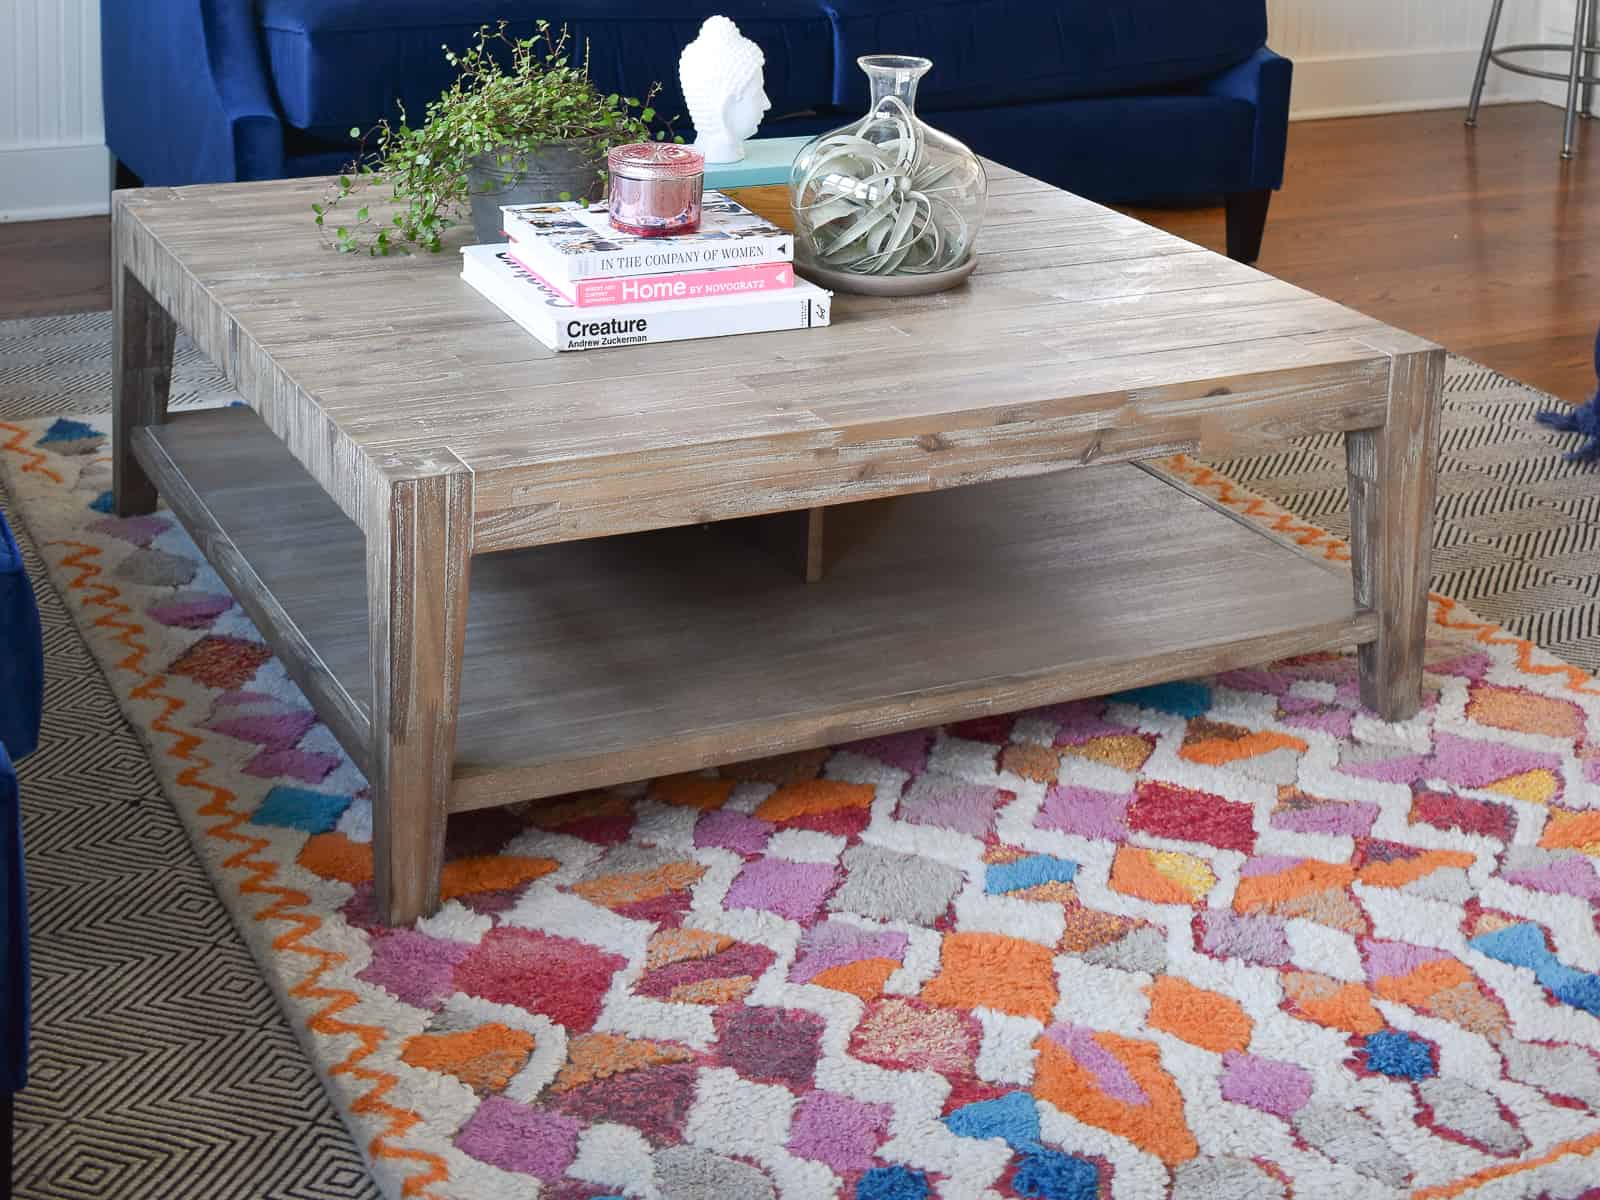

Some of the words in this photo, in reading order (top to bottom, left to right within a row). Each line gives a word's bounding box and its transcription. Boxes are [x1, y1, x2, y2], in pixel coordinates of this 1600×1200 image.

[601, 258, 614, 270] IN
[616, 256, 641, 269] THE
[645, 251, 700, 266] COMPANY
[703, 249, 718, 261] OF
[721, 246, 764, 259] WOMEN
[622, 280, 686, 300] Home
[689, 286, 702, 294] BY
[567, 319, 648, 338] Creature
[568, 339, 600, 349] Andrew
[601, 335, 648, 346] Zuckerman
